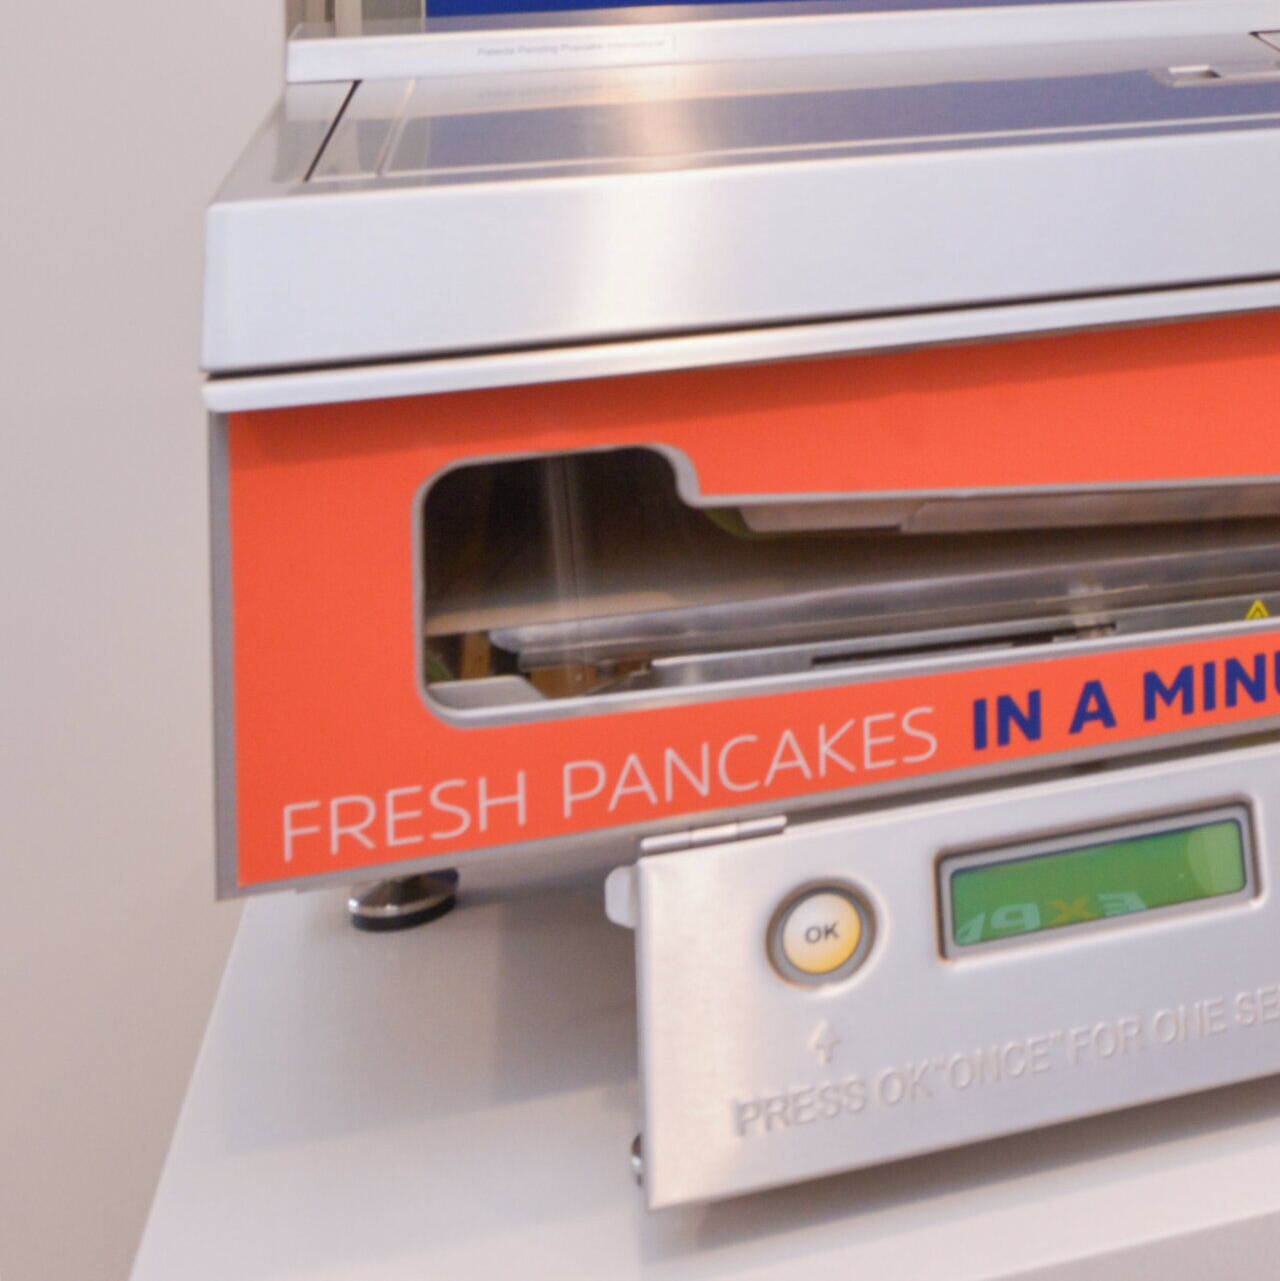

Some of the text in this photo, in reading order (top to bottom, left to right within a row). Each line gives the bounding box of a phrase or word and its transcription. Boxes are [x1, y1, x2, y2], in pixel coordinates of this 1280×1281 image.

[282, 770, 528, 863] FRESH
[562, 706, 939, 819] PANCAKES
[972, 689, 1042, 751] IN
[1068, 679, 1118, 735] A
[804, 920, 840, 945] OK
[732, 1075, 869, 1137] PRESS
[878, 1057, 934, 1106] OK
[1068, 1014, 1147, 1066] FOR
[1153, 994, 1229, 1047] ONE
